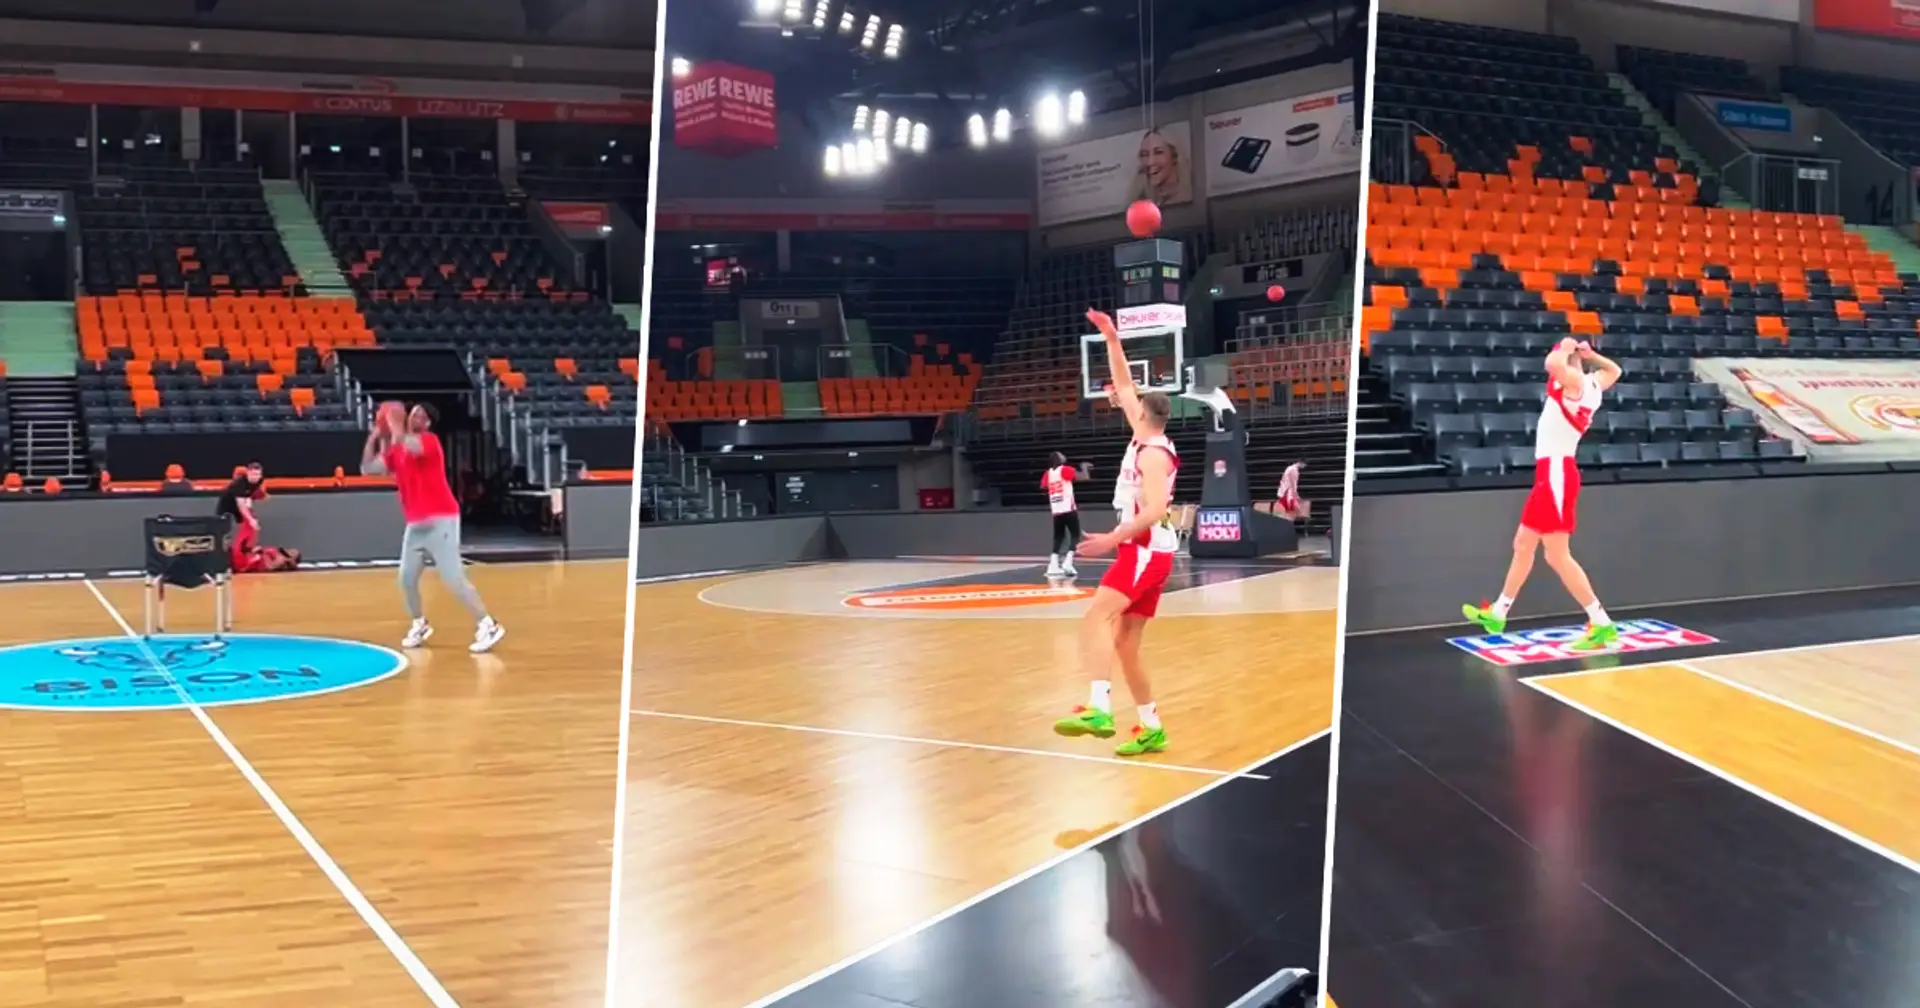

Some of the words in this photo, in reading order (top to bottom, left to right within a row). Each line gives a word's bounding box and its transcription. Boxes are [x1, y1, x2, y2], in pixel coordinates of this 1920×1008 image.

[673, 77, 717, 110] REWE
[719, 77, 775, 108] REWE
[1209, 116, 1242, 130] beurer
[1120, 311, 1160, 325] beurer
[1200, 512, 1238, 526] LIQUI
[1199, 526, 1240, 540] MOLY
[22, 665, 322, 694] BISON
